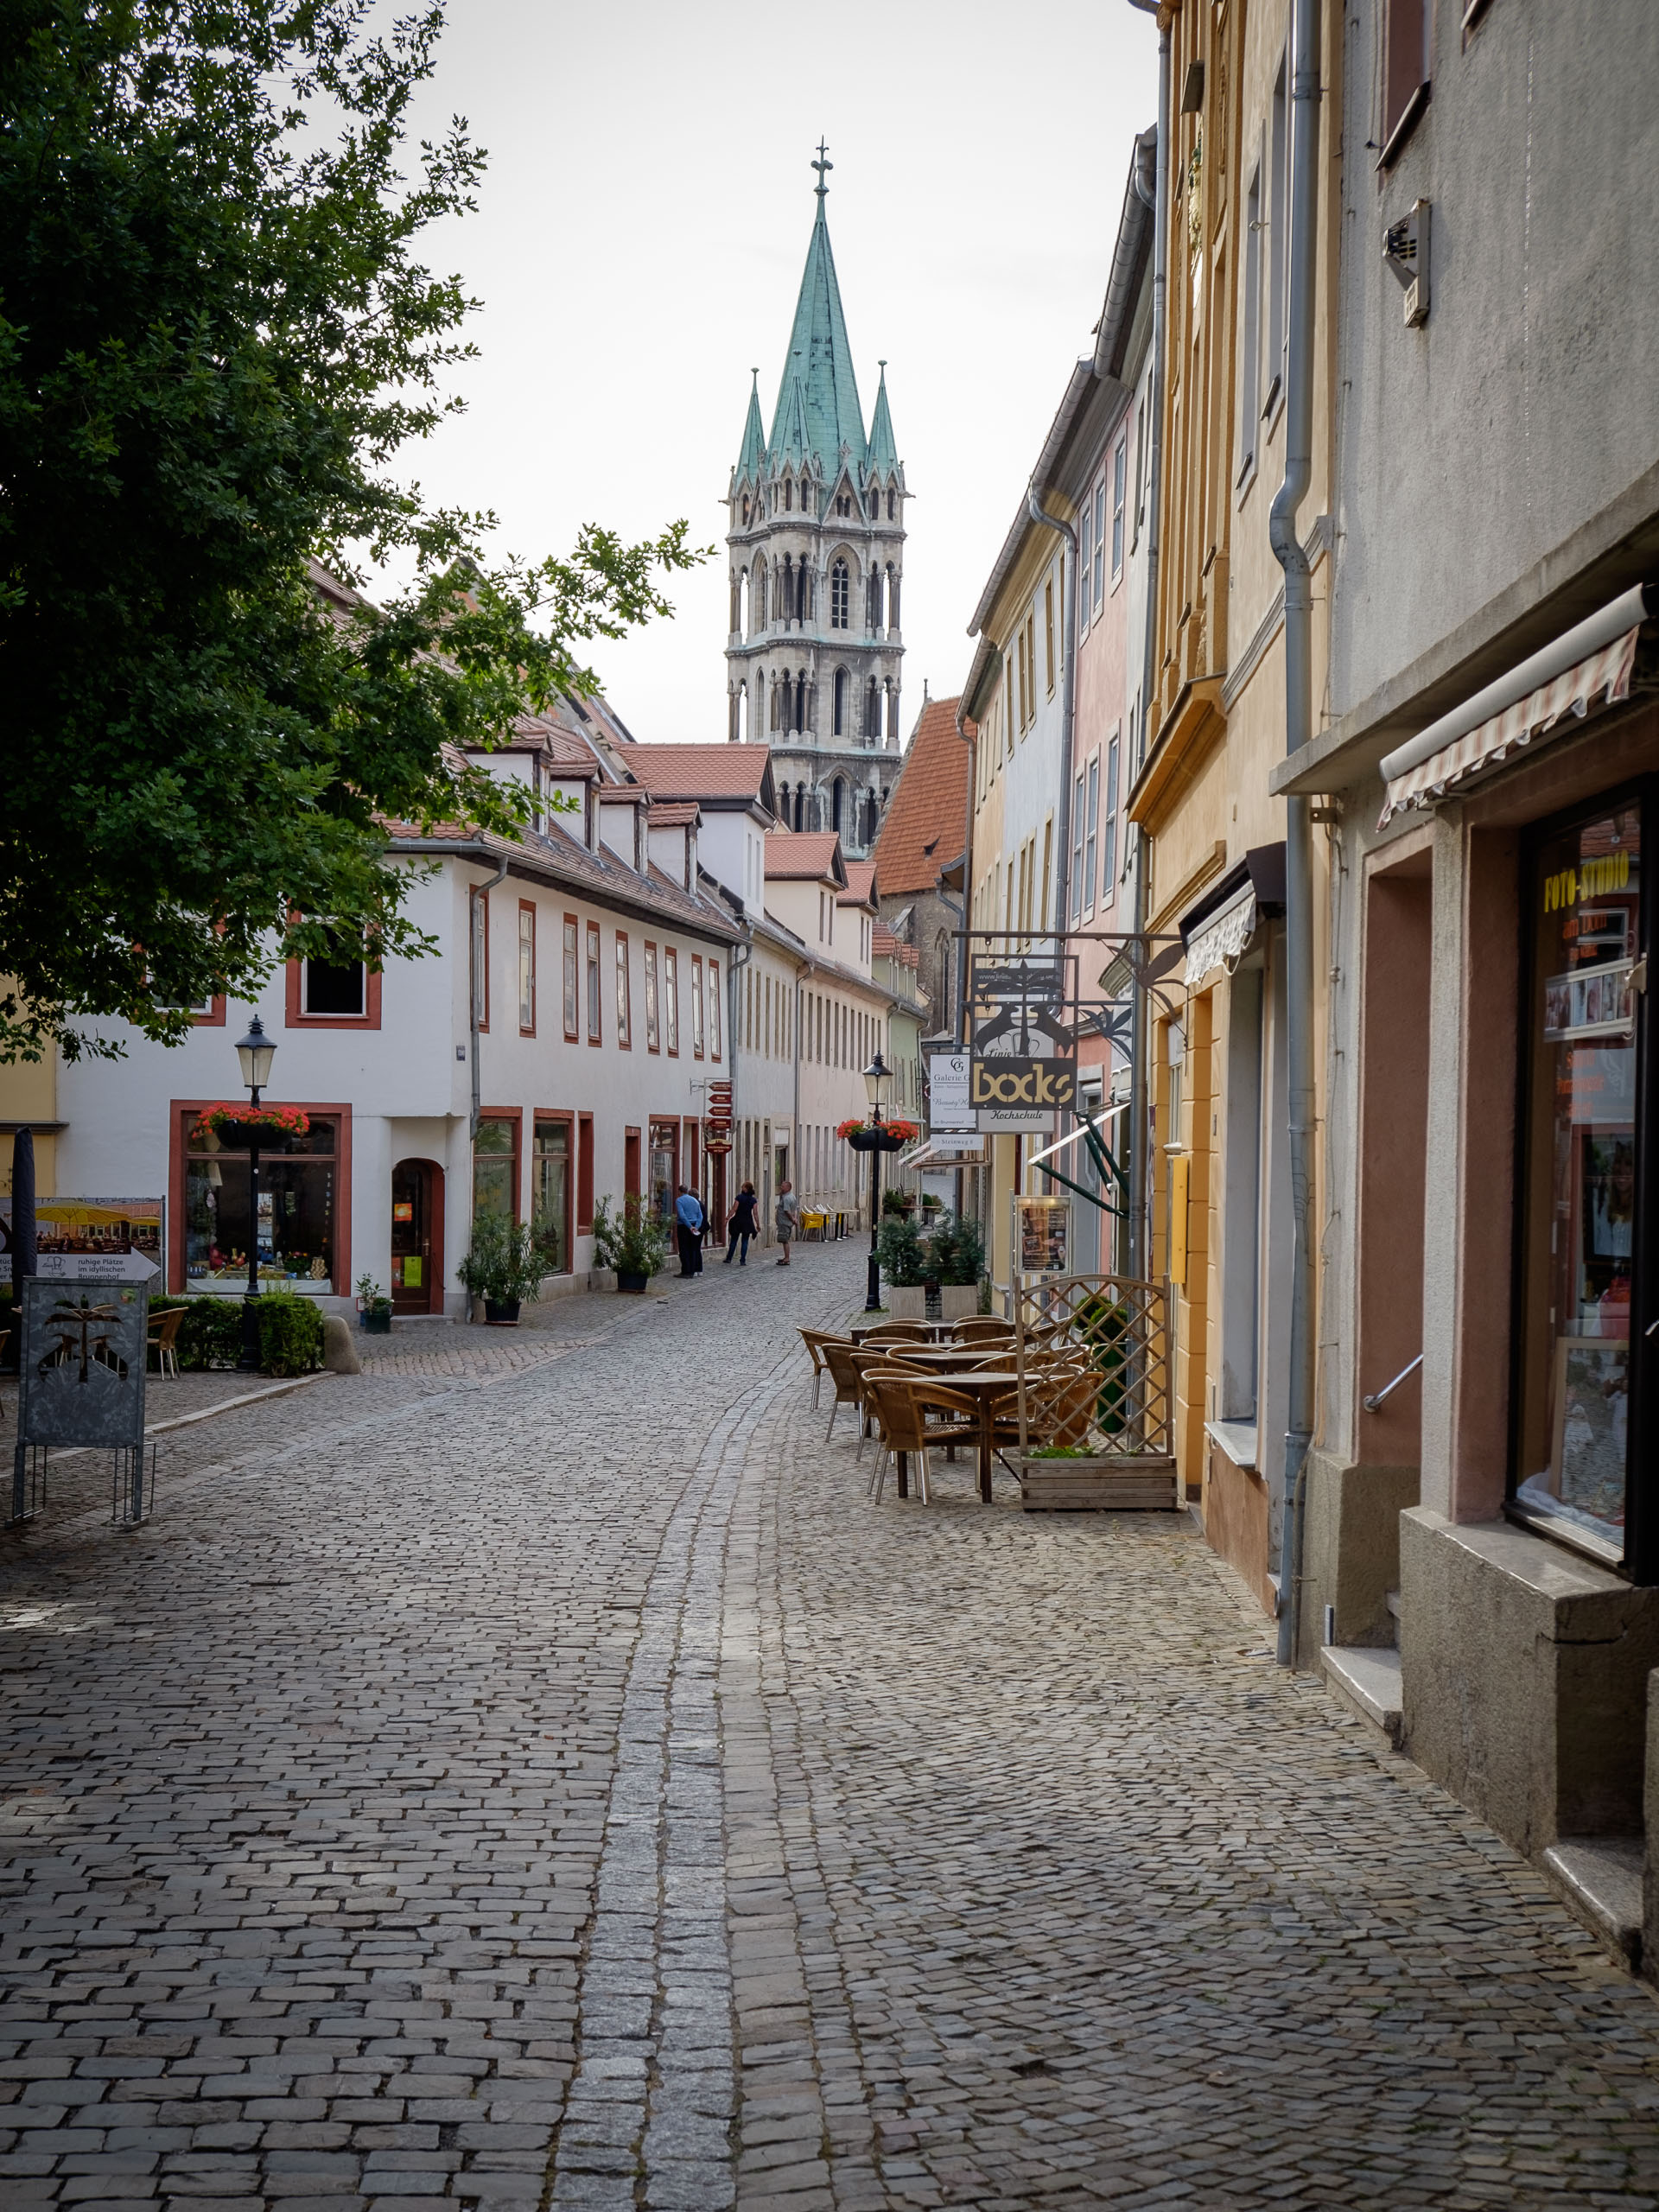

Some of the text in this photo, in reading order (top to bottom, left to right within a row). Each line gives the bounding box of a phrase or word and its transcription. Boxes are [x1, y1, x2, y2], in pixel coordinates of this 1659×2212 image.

[1543, 849, 1630, 913] FOTO-STUDIO
[934, 1073, 962, 1082] Galerie
[973, 1062, 1074, 1103] bocks
[990, 1109, 1044, 1120] Kochschule
[78, 1258, 100, 1269] ruhige
